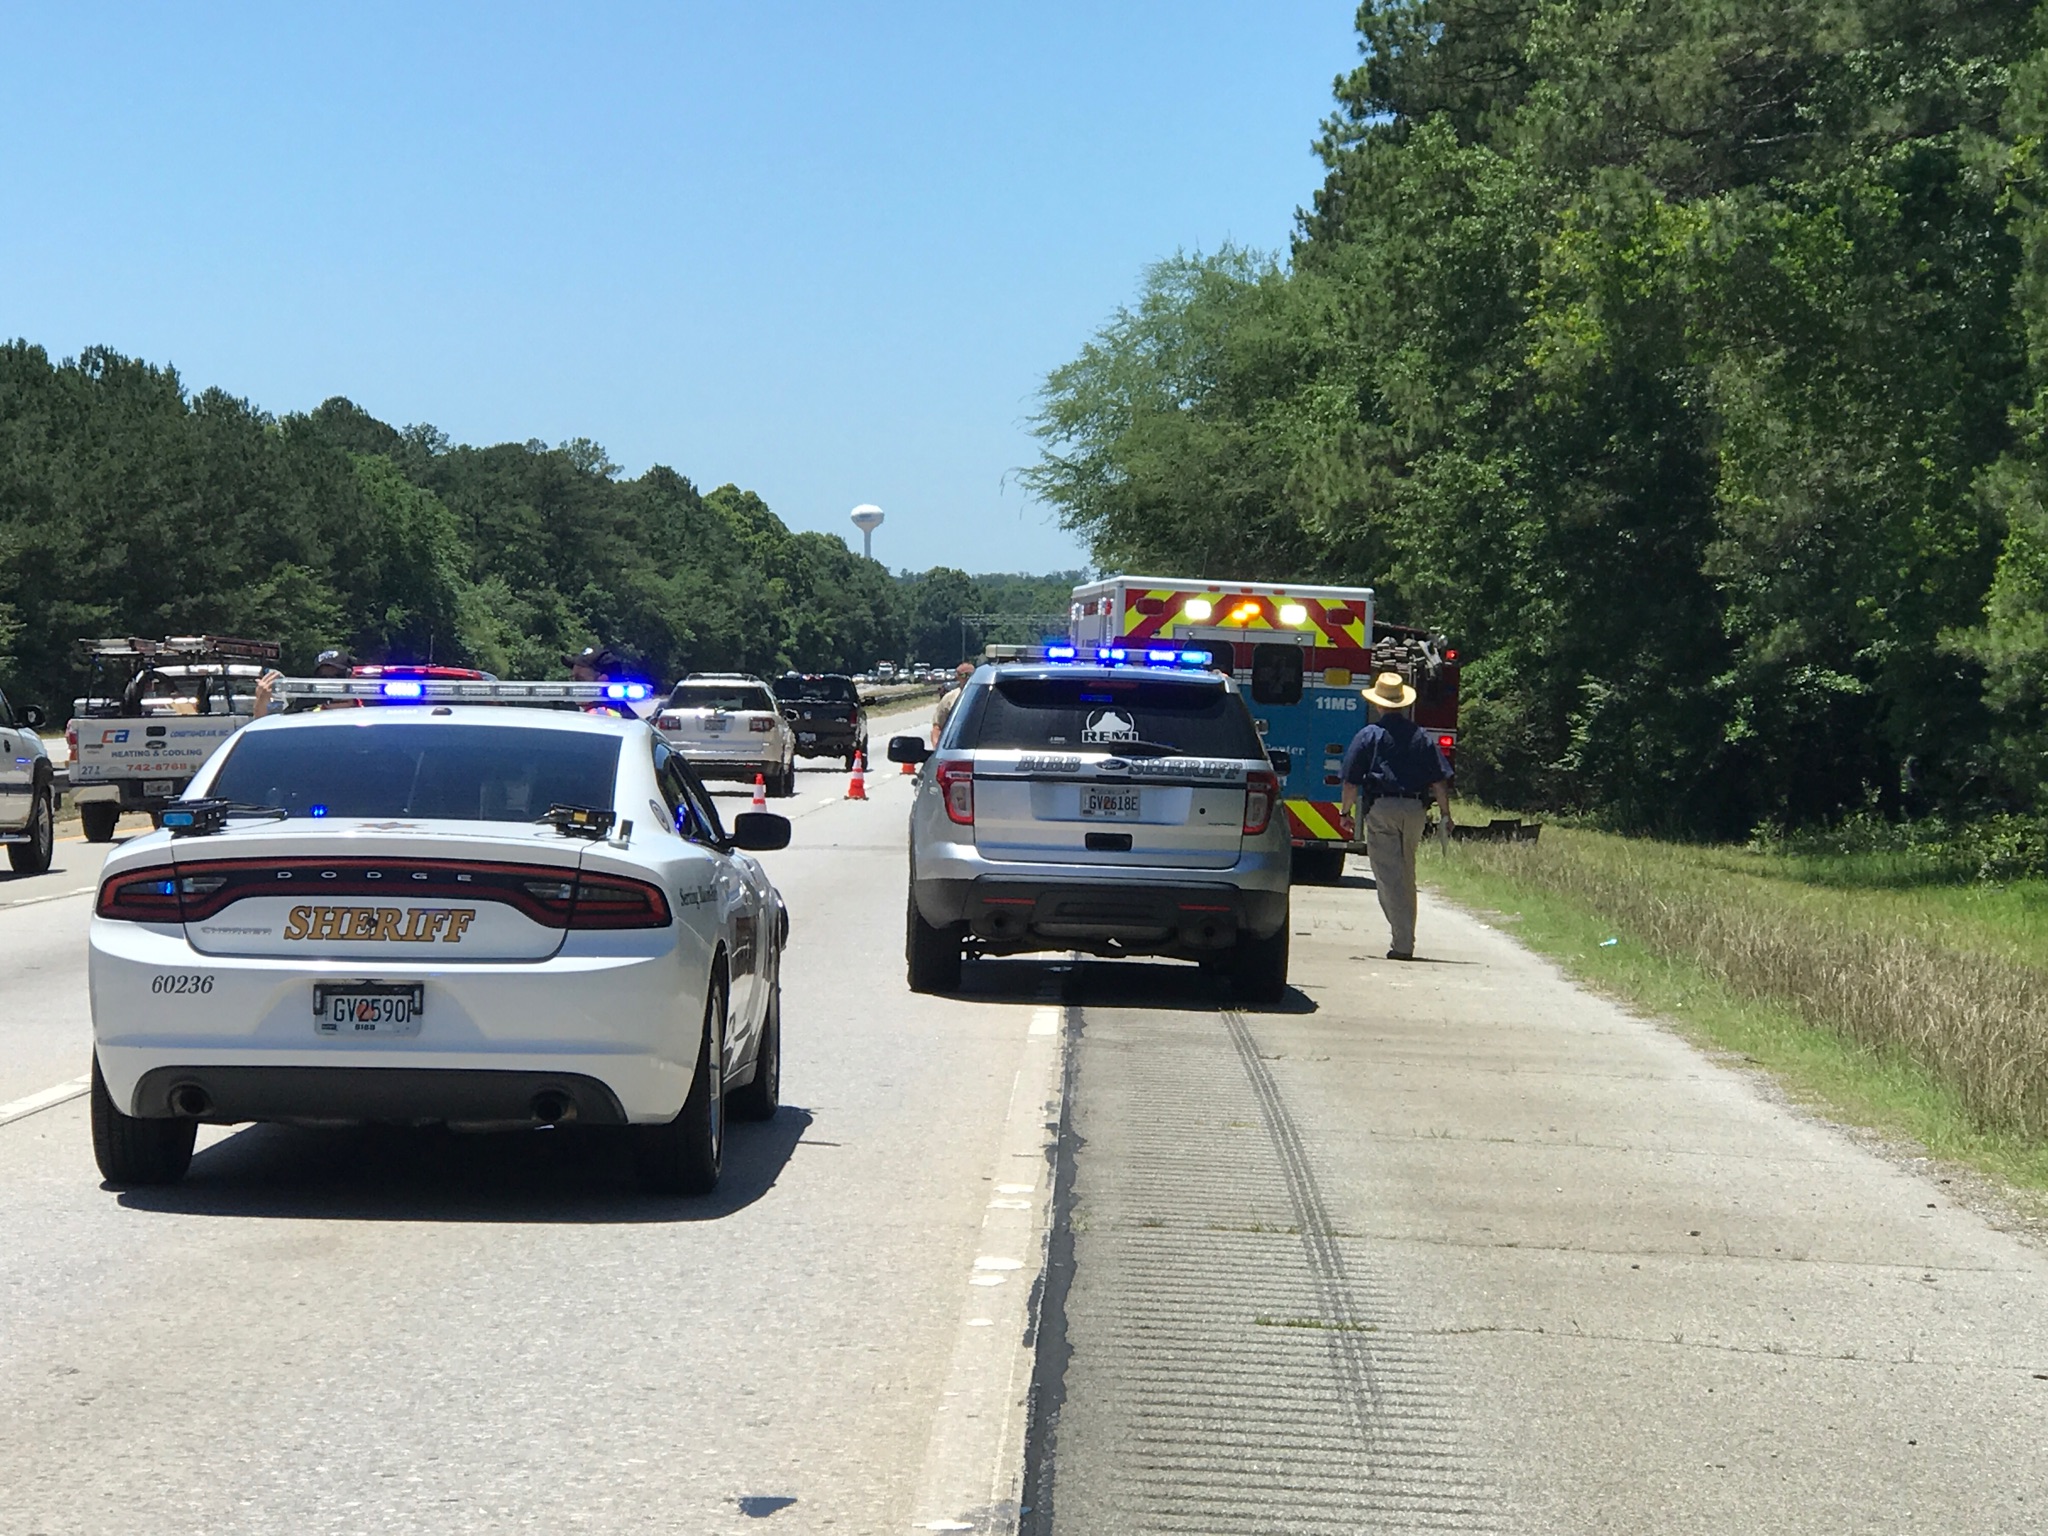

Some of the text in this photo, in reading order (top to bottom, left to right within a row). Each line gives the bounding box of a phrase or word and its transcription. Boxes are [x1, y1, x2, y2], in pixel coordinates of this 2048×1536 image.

[1315, 696, 1357, 711] 11M5
[1082, 730, 1139, 744] REMI
[111, 749, 202, 758] HEATING & COOLING
[1015, 755, 1082, 773] BIBB
[1128, 759, 1243, 780] SHERIFF
[1089, 795, 1138, 811] GV2618E
[276, 871, 472, 882] DODGE
[283, 905, 476, 943] SHERIFF
[151, 975, 215, 995] 60236
